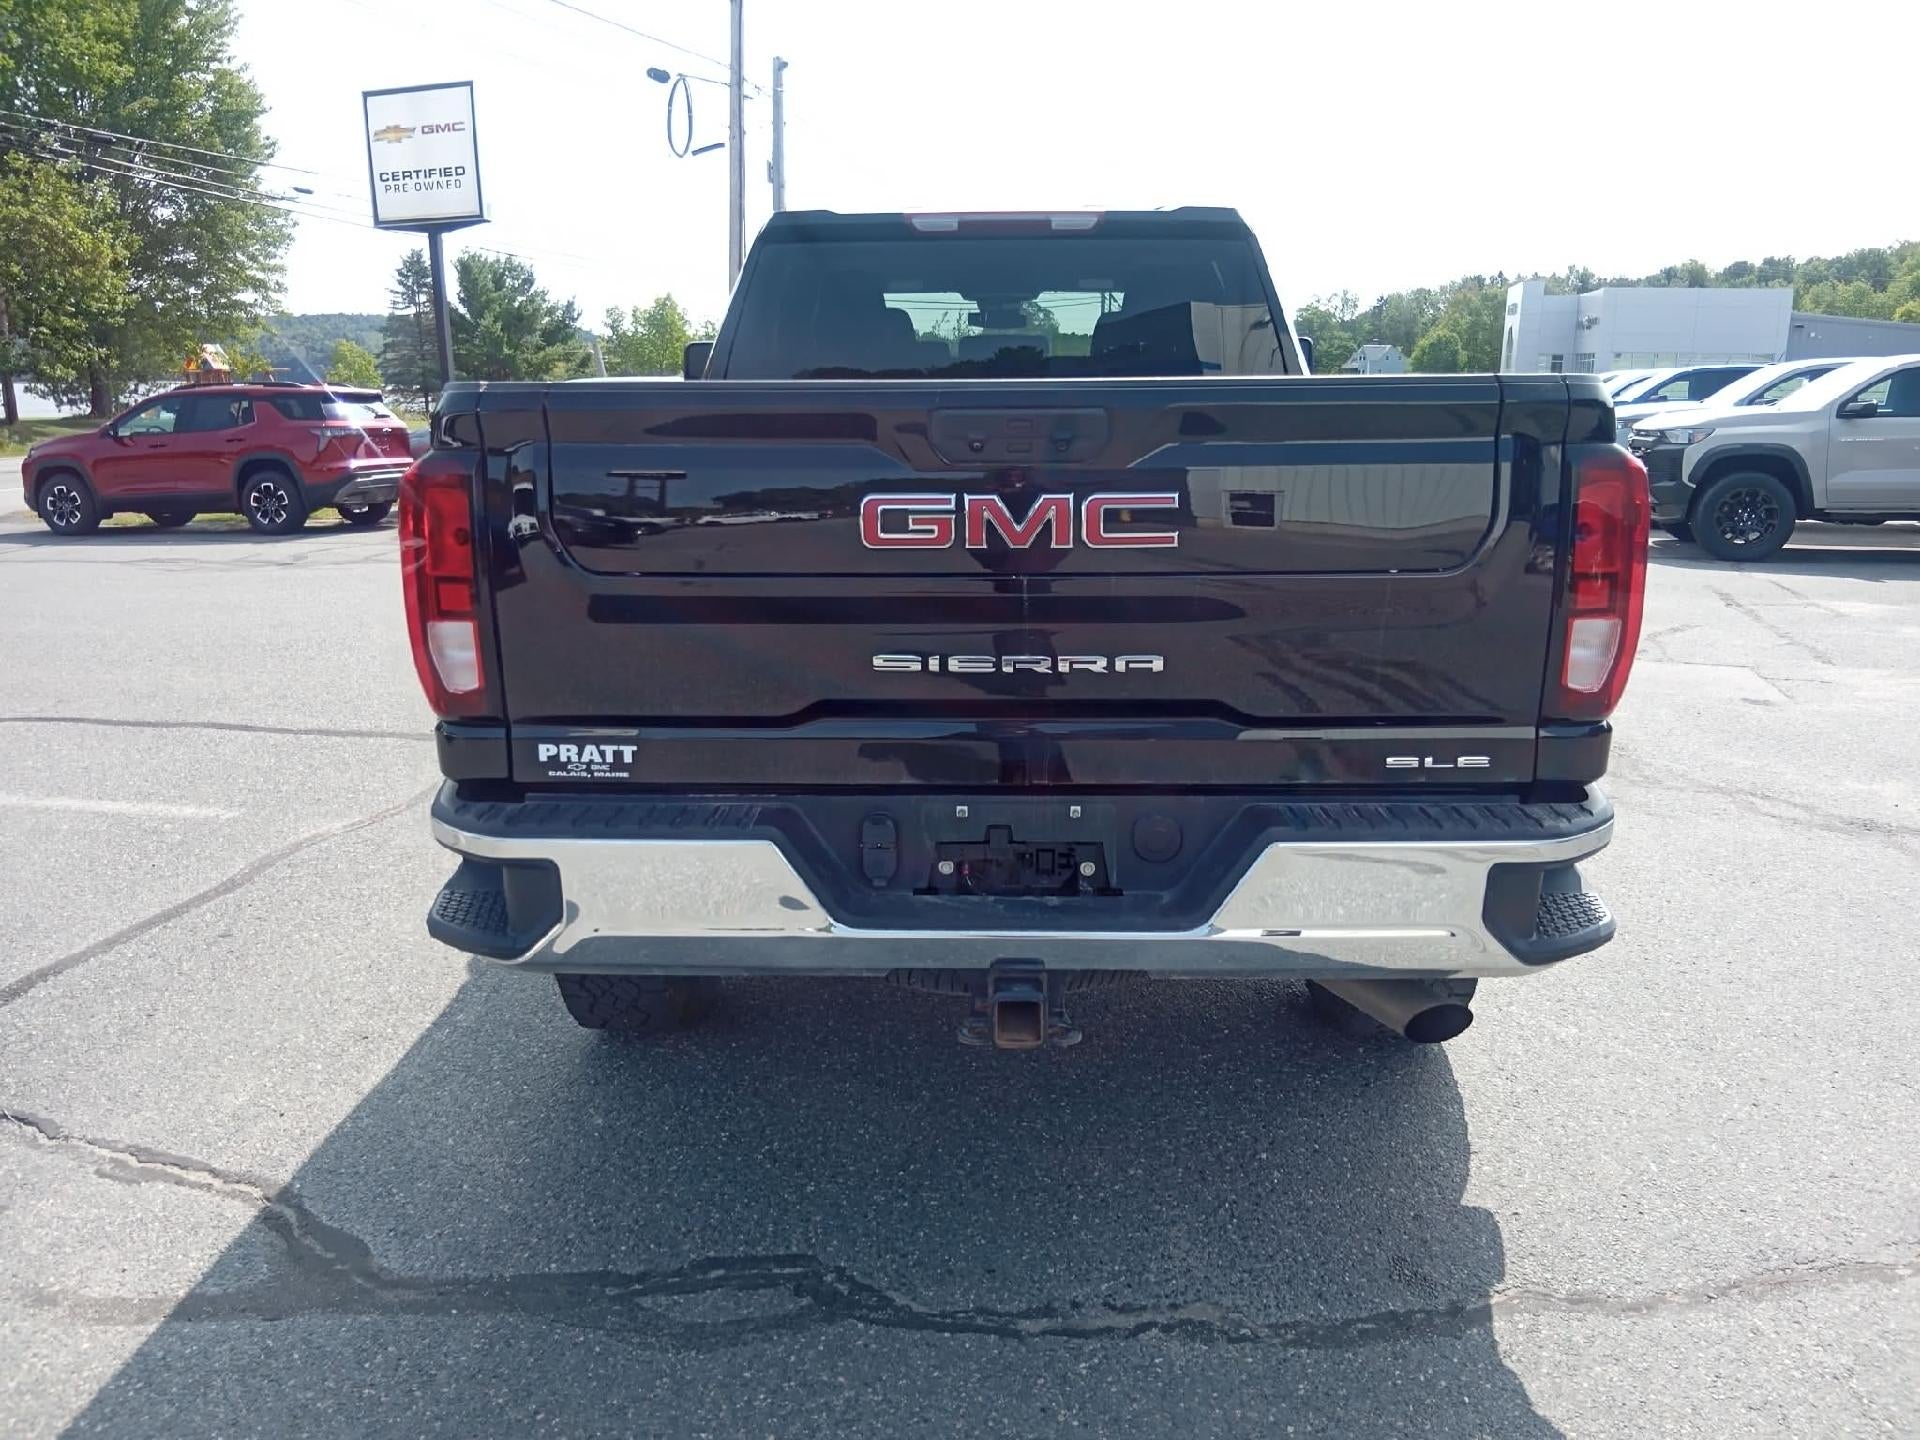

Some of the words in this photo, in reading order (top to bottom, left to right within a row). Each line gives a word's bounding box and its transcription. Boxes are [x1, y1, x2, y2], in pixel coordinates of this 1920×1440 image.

[421, 121, 466, 135] GMC
[379, 165, 466, 183] CERTIFIED
[859, 491, 1179, 550] GMC
[872, 654, 1164, 674] SIERRA
[538, 743, 638, 763] PRATT
[1385, 756, 1491, 768] SLE
